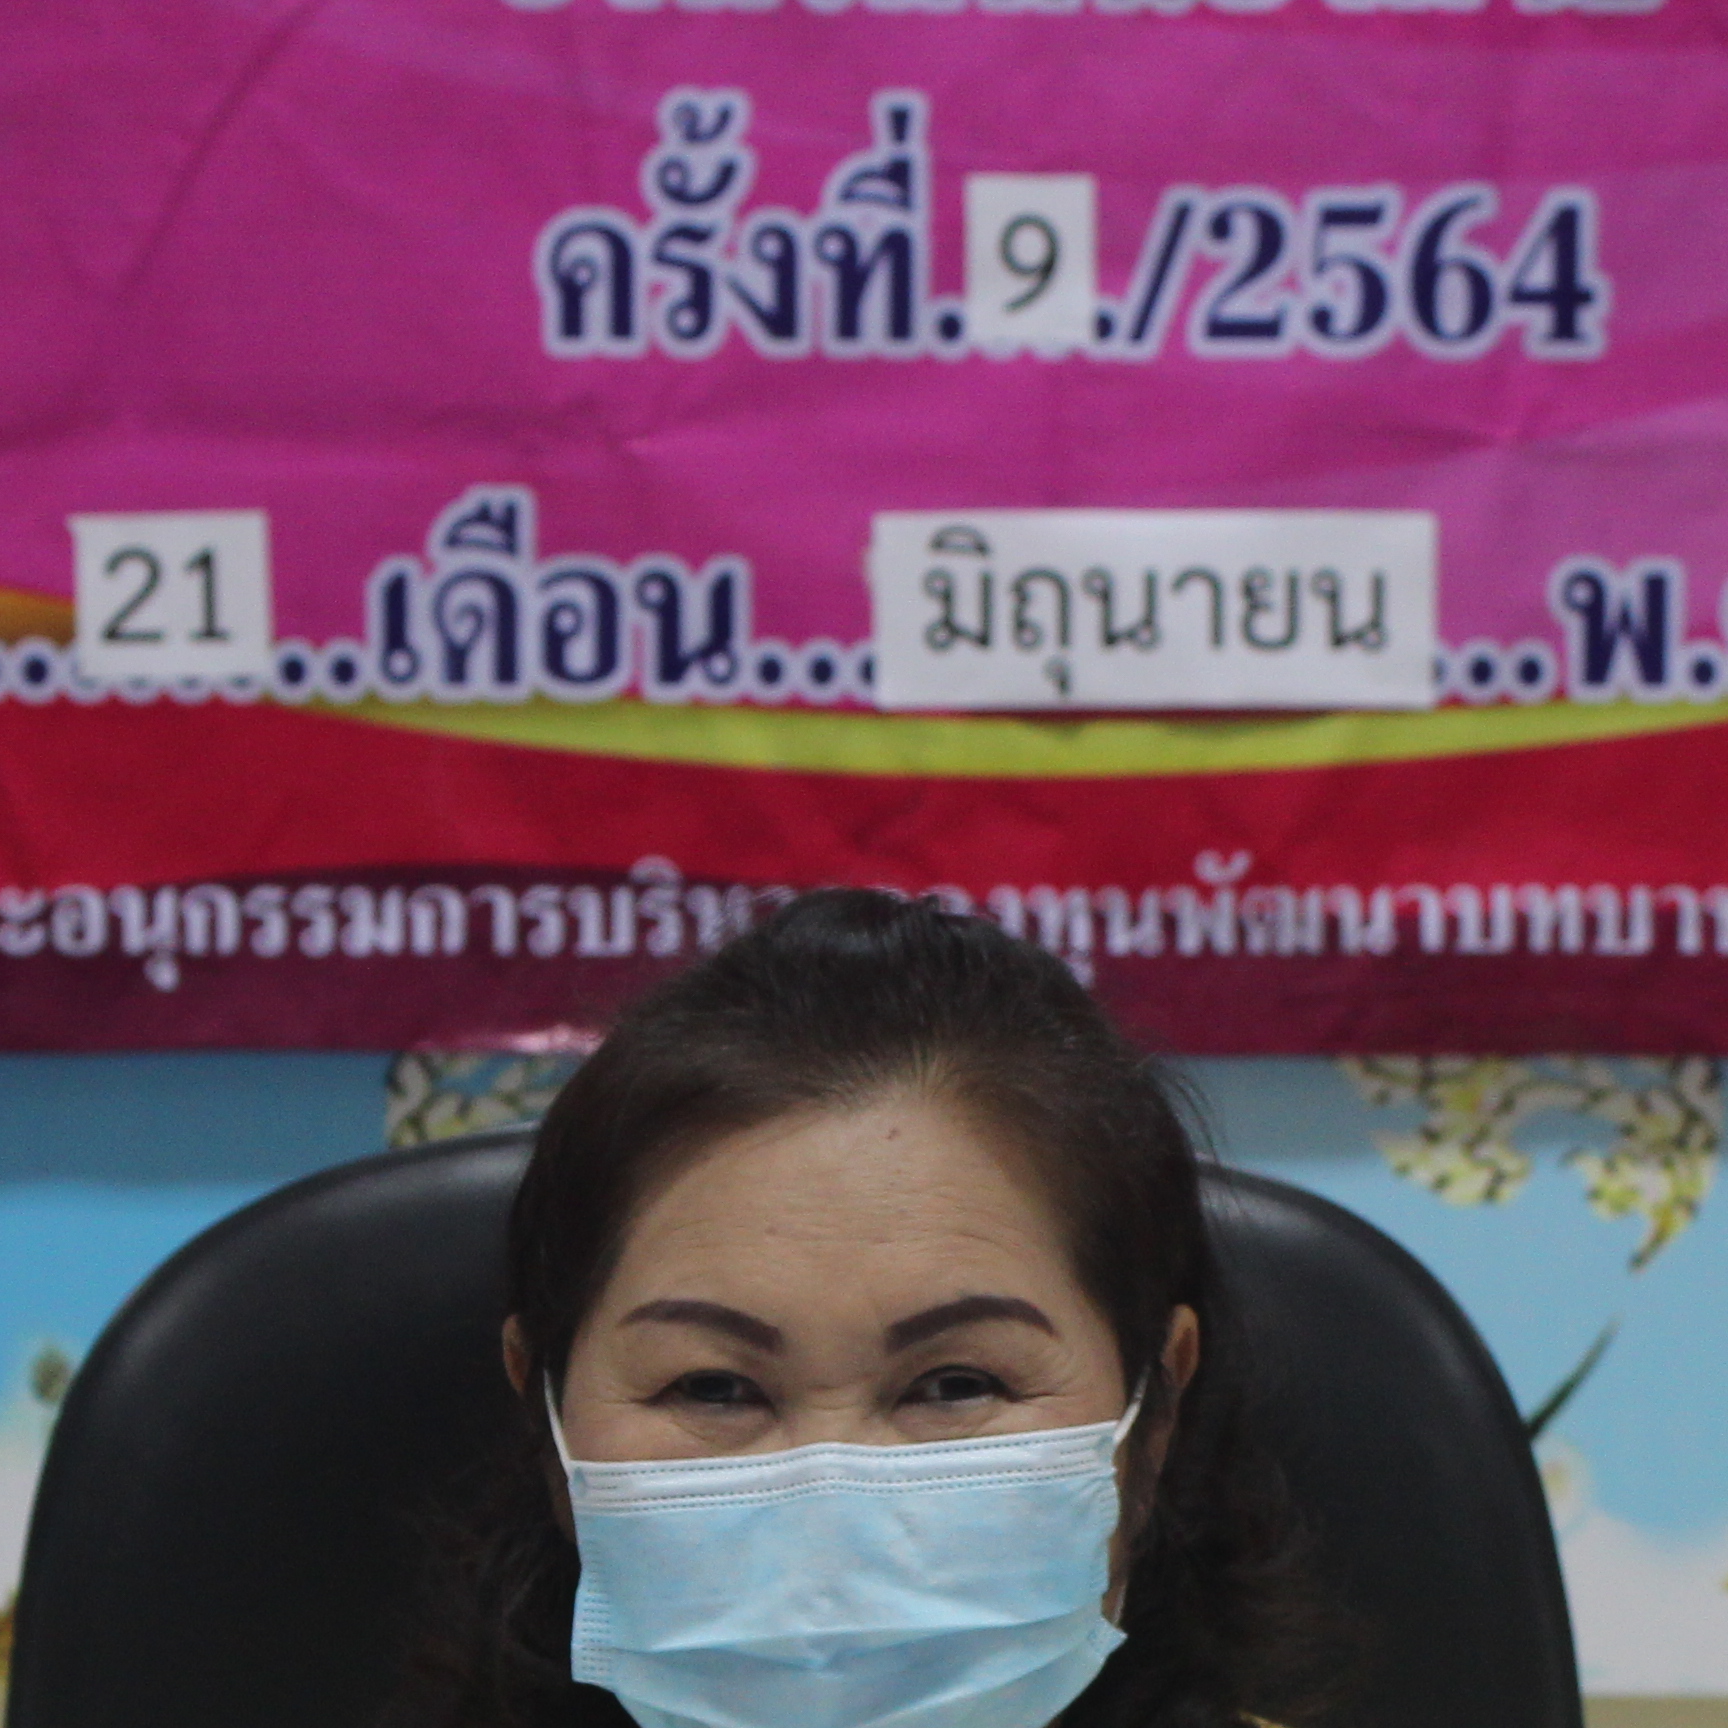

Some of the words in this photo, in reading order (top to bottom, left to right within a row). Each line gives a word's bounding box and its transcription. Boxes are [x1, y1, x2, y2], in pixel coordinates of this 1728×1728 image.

[100, 546, 235, 646] 21
[920, 522, 1390, 700] มิถุนายน
